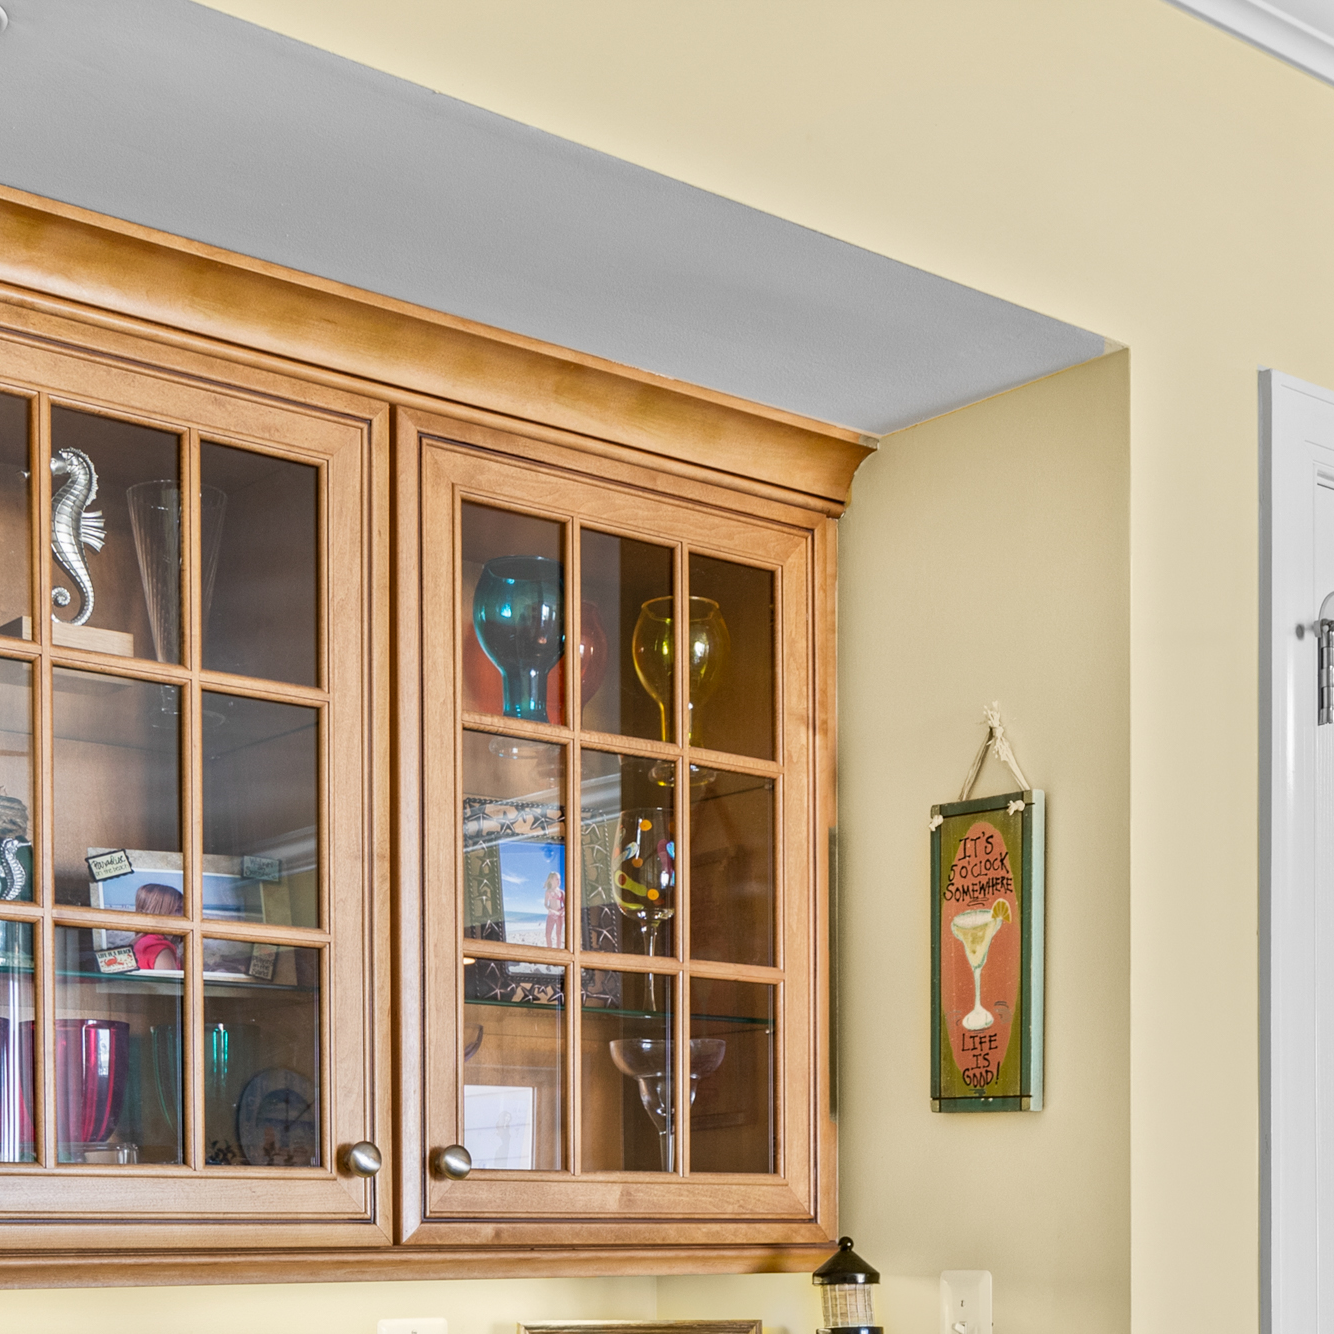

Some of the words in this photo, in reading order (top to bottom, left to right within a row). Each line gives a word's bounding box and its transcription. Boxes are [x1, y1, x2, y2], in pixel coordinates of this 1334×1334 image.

[958, 831, 994, 861] IT'S
[943, 876, 1013, 902] SOMEWHERE
[961, 1033, 998, 1051] LIFE
[962, 1060, 1000, 1088] GOOD!
[971, 1052, 990, 1070] IS
